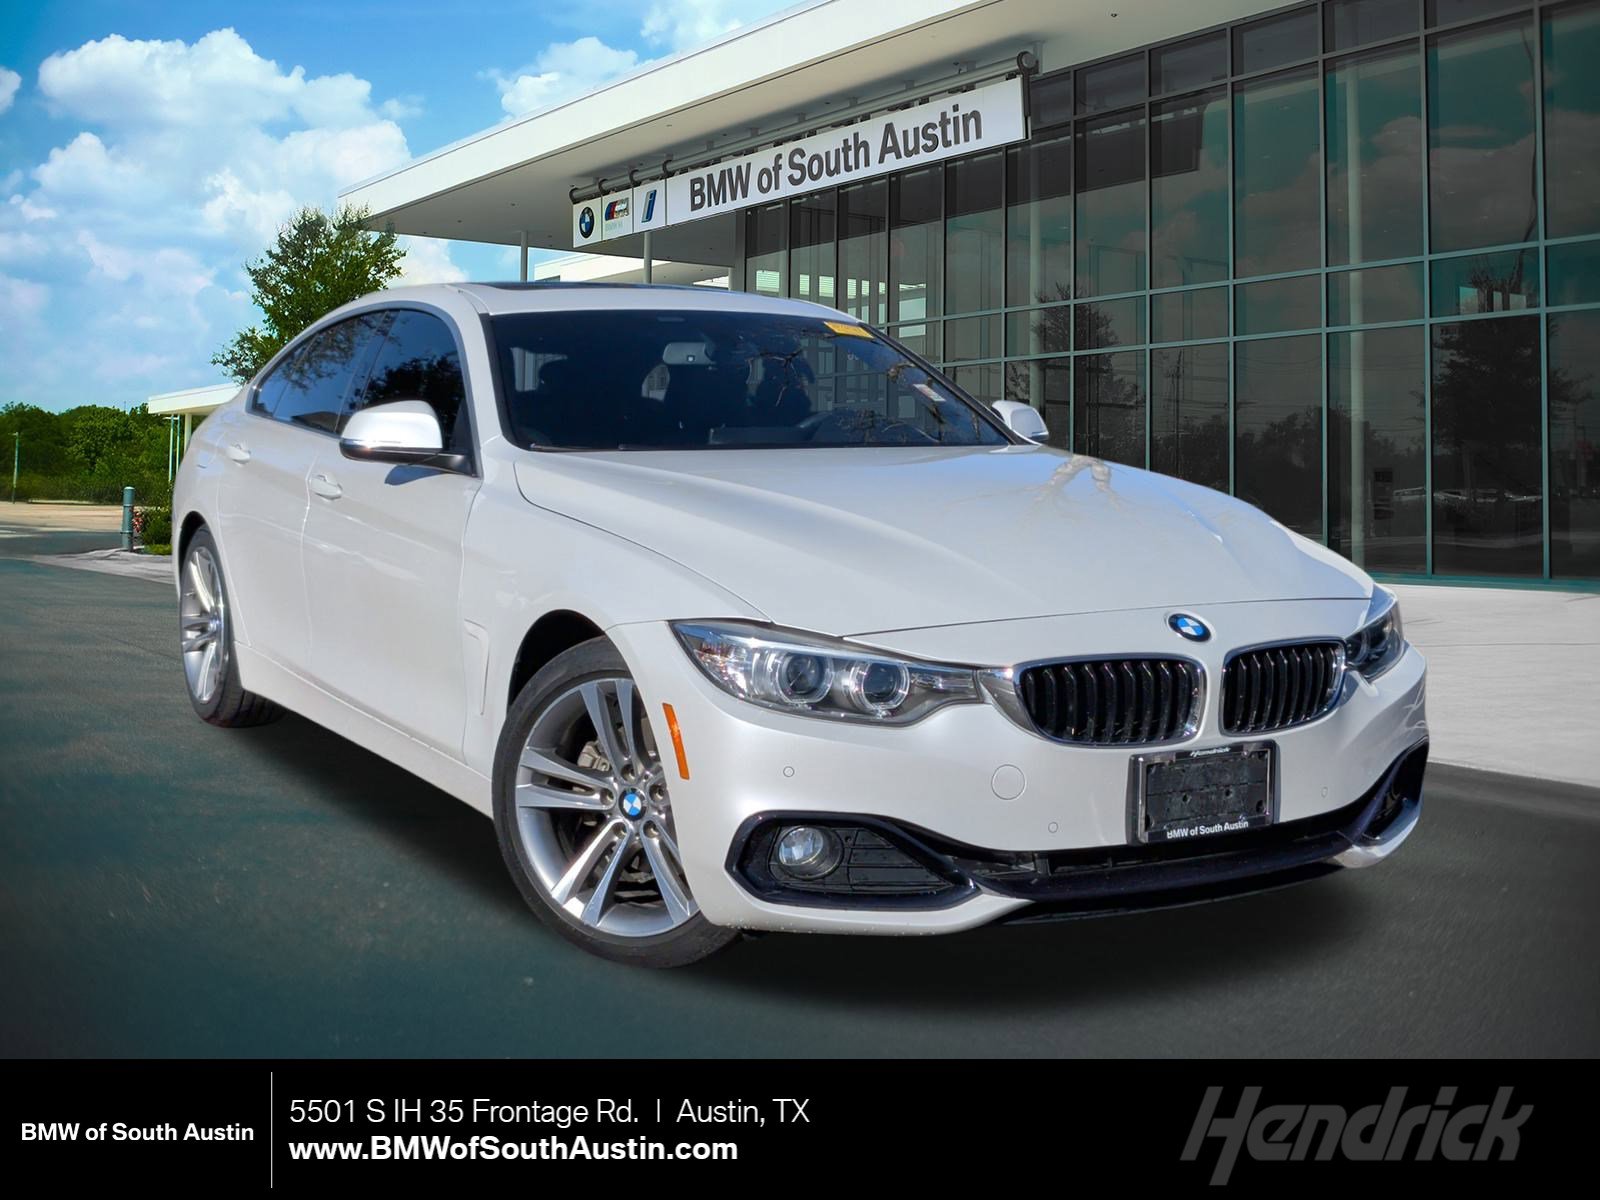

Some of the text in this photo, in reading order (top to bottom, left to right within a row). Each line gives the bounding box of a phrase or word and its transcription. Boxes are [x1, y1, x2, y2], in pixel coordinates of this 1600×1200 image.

[690, 163, 750, 211] BMW
[757, 153, 783, 194] of
[788, 132, 870, 186] South
[878, 104, 982, 163] Austin
[1190, 826, 1198, 836] of
[1200, 823, 1223, 835] South
[1224, 820, 1249, 831] Austin
